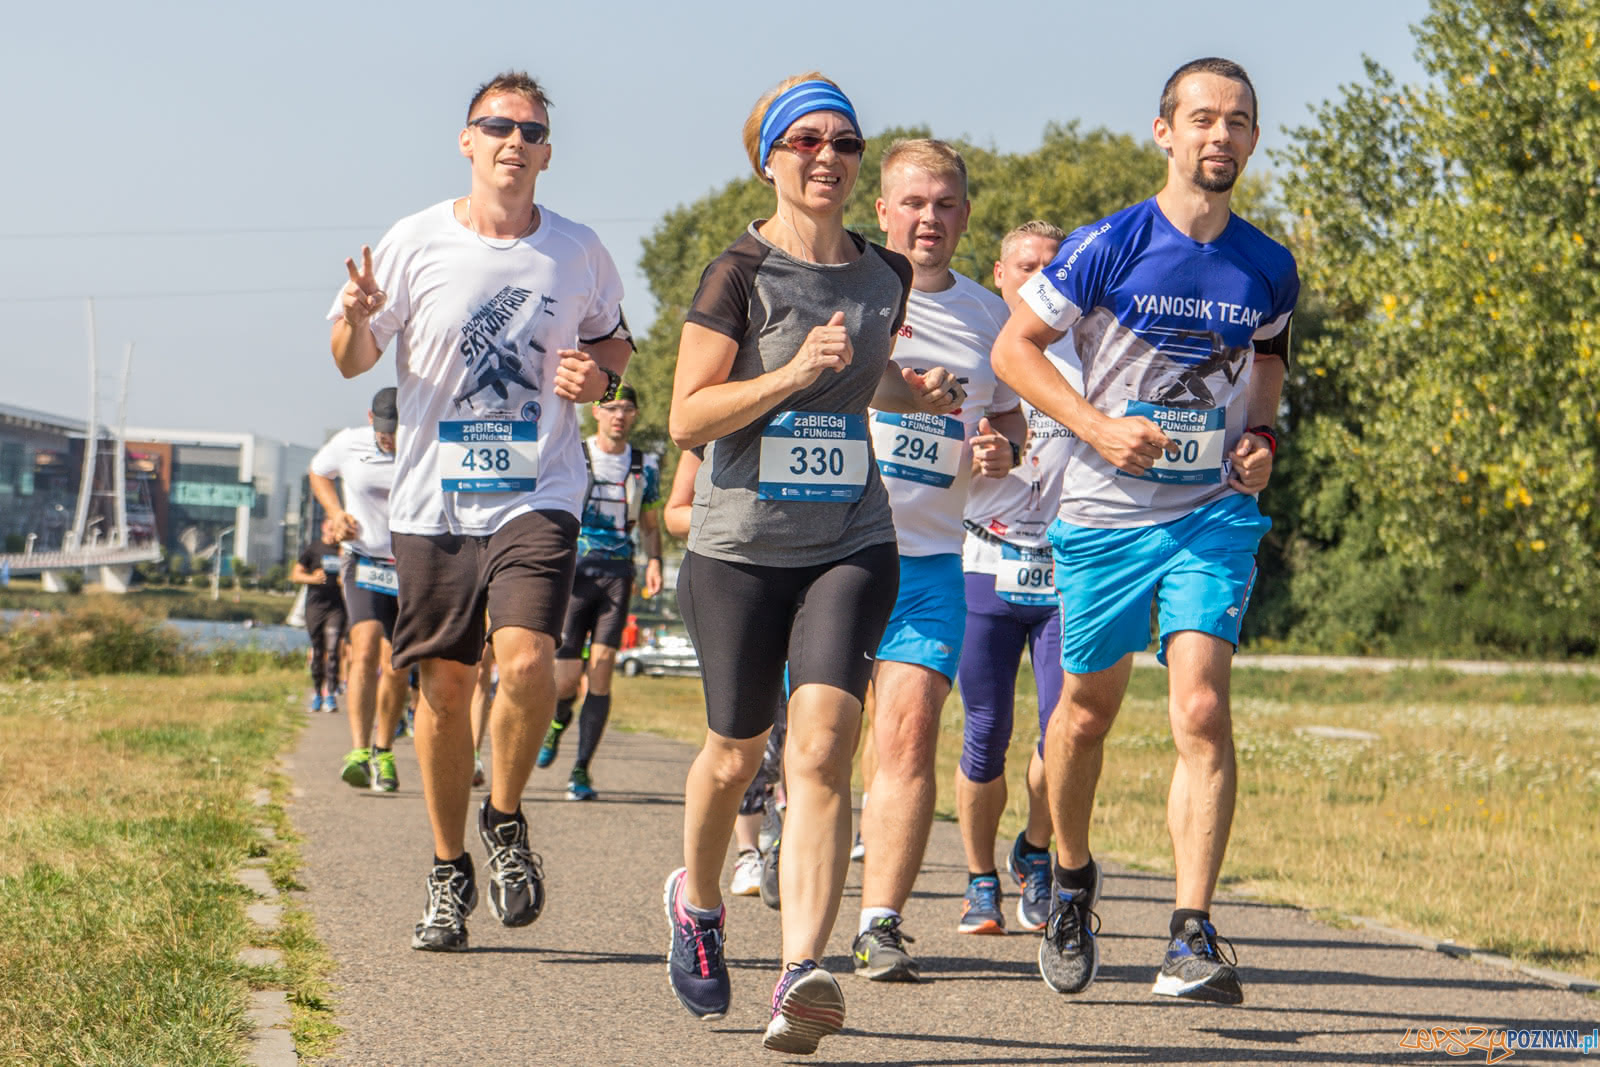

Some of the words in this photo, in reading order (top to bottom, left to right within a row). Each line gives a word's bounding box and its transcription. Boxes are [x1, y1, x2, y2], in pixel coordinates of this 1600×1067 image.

[1133, 294, 1214, 320] YANOSIK
[1217, 302, 1263, 328] TEAM
[794, 415, 846, 430] zaBIEGaj
[902, 412, 946, 429] zaBIEGaj
[1153, 410, 1208, 424] zaBIEGaj
[463, 423, 512, 436] zaBIEGaj
[803, 427, 846, 438] FUNdusze
[908, 421, 945, 435] FUNdusze
[1160, 420, 1206, 432] FUNdusze
[471, 433, 512, 441] FUNdusze
[892, 434, 939, 465] 294
[1165, 438, 1199, 464] 60
[462, 448, 510, 471] 438
[789, 446, 844, 476] 330
[1017, 567, 1053, 587] 096
